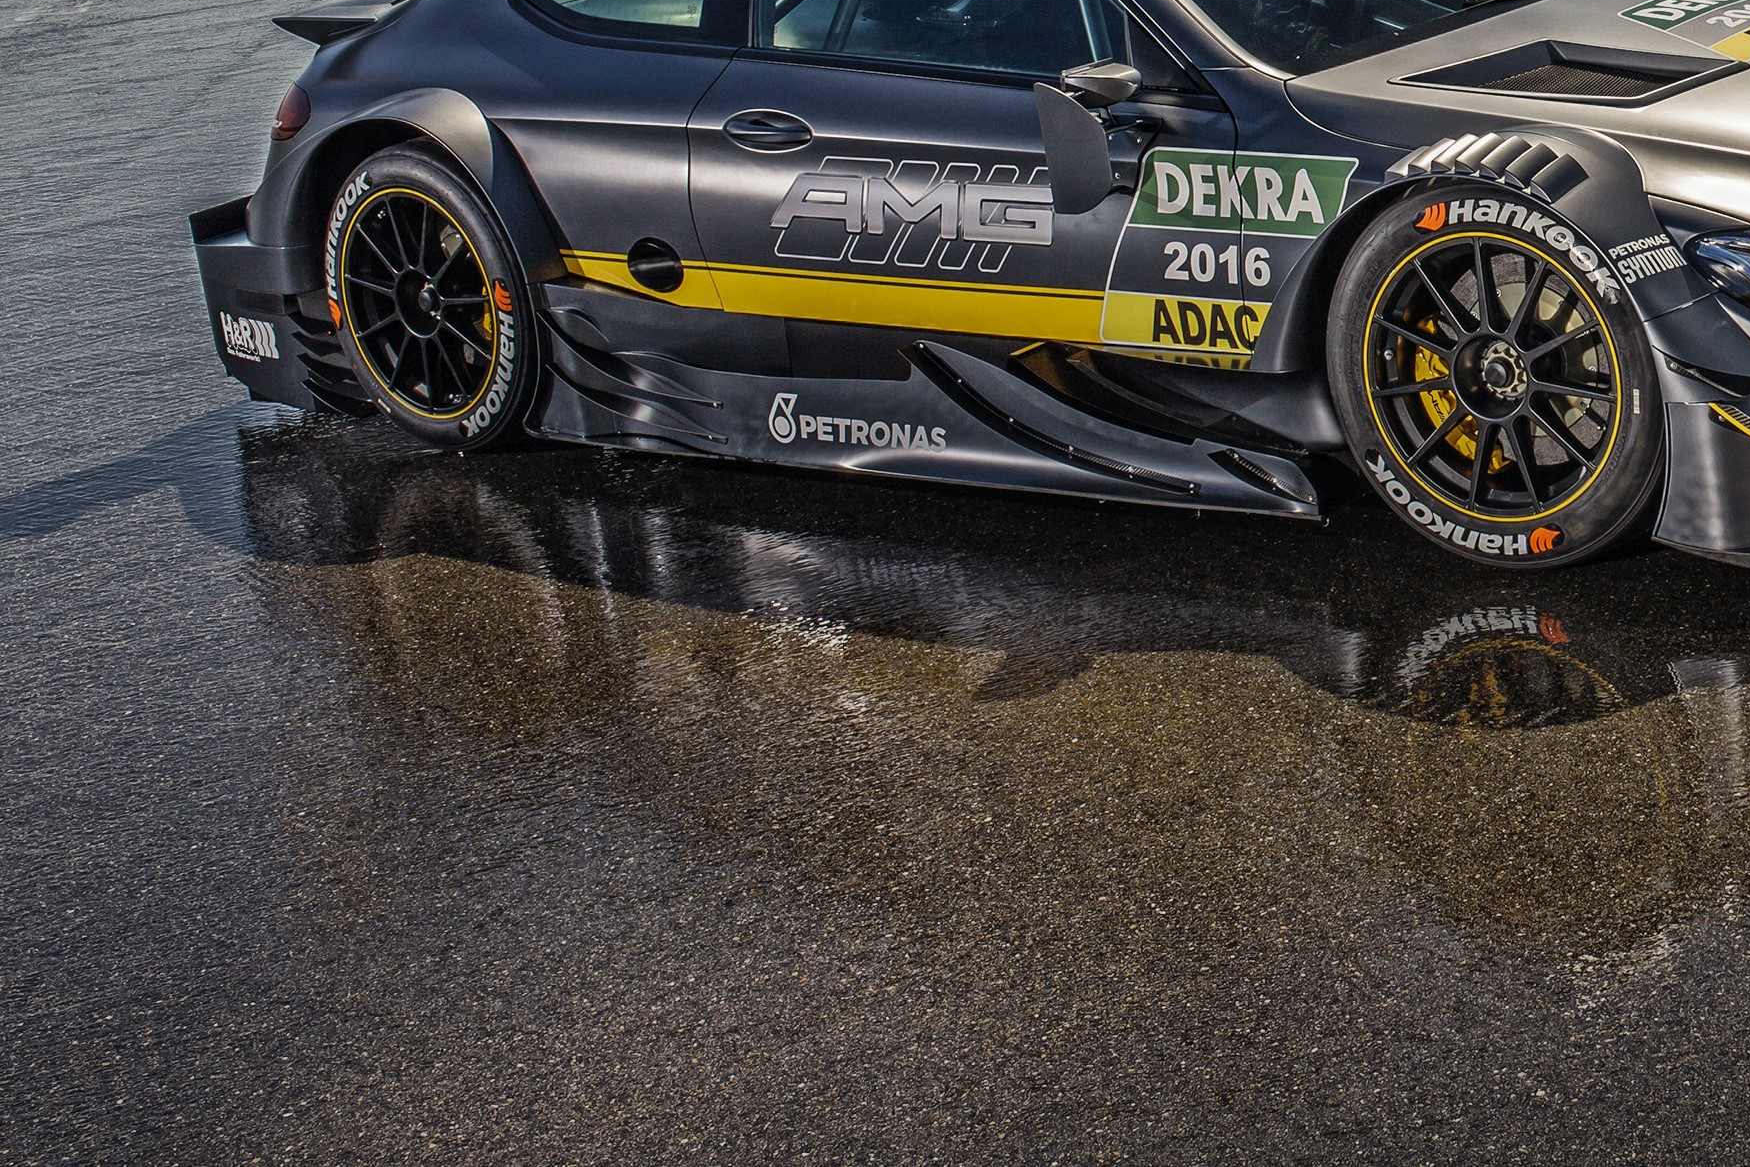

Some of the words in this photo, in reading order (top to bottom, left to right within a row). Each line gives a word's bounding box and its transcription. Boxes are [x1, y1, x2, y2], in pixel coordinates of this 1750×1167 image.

[770, 171, 1054, 246] AMG
[1152, 160, 1326, 225] DEKRA
[1163, 240, 1272, 288] 2016
[1608, 233, 1671, 260] PETRONAS
[1617, 245, 1688, 285] SYNTIUM
[1151, 298, 1260, 352] ADAC
[799, 414, 947, 453] PETRONAS
